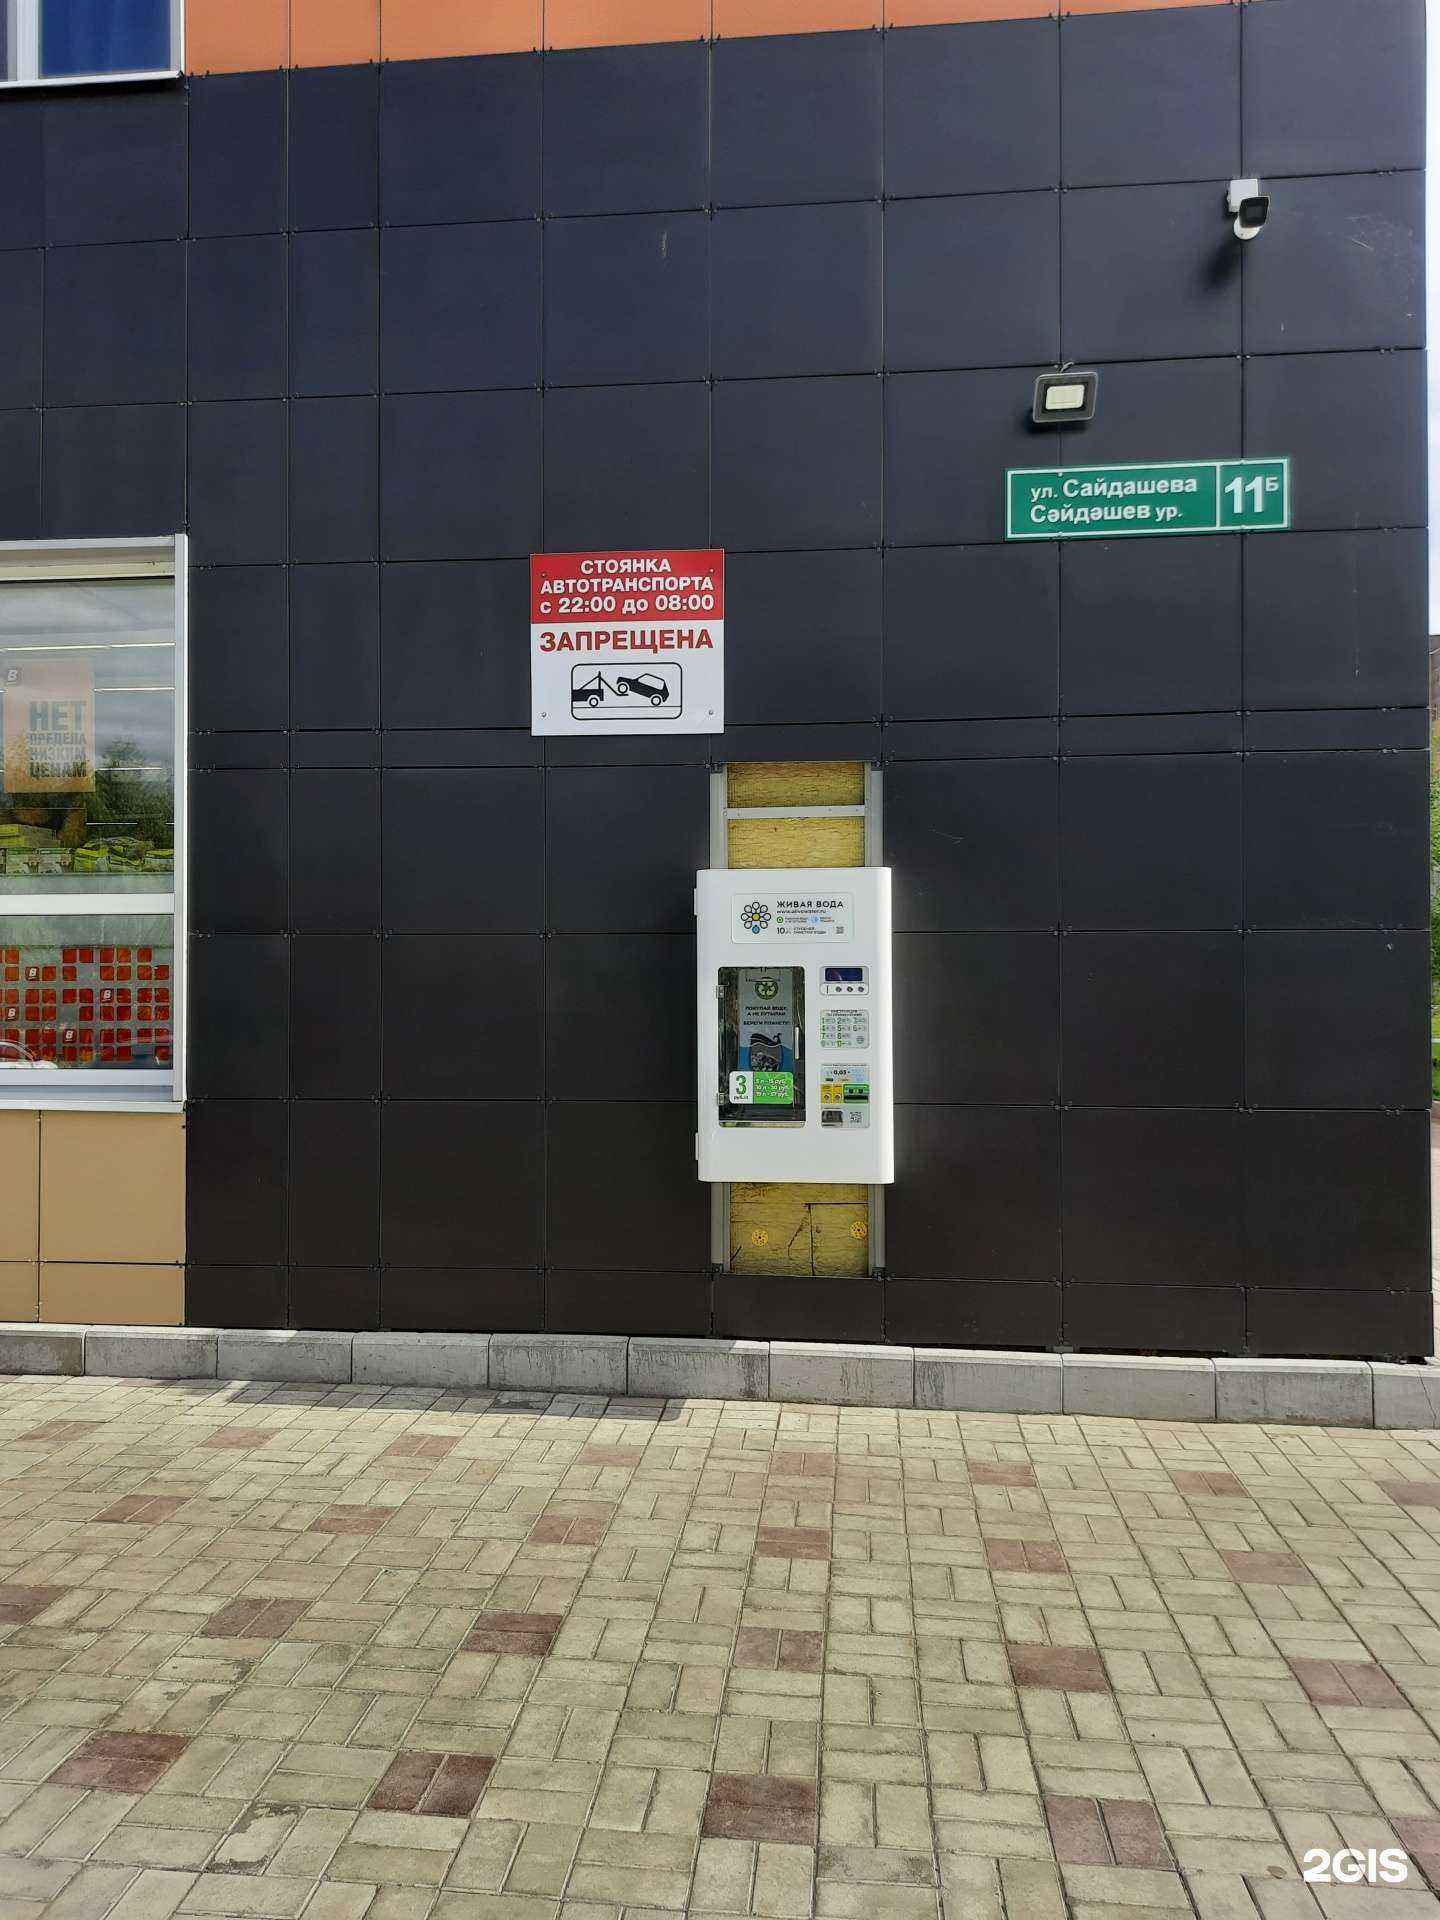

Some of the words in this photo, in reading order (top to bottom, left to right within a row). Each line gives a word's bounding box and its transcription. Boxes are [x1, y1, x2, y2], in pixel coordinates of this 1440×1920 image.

[1030, 486, 1058, 502] ул.
[1062, 477, 1198, 499] Сайдашева
[1030, 503, 1151, 525] Сәйдәшев
[1155, 506, 1184, 522] ур.
[580, 558, 672, 575] СТОЯНКА
[540, 576, 714, 595] АВТОТРАНСПОРТА
[558, 596, 616, 613] 22:00
[622, 599, 649, 614] до
[655, 594, 714, 611] 08:00
[540, 628, 714, 654] ЗАПРЕЩЕНА
[29, 701, 87, 731] НЕТ
[29, 732, 87, 745] ПРЕДЕЛА
[30, 746, 87, 761] НИЗКИМ
[29, 761, 87, 779] ЦЕНАМ
[776, 900, 813, 908] ЖИВАЯ
[816, 900, 844, 908] ВОДА
[735, 1074, 747, 1095] 3
